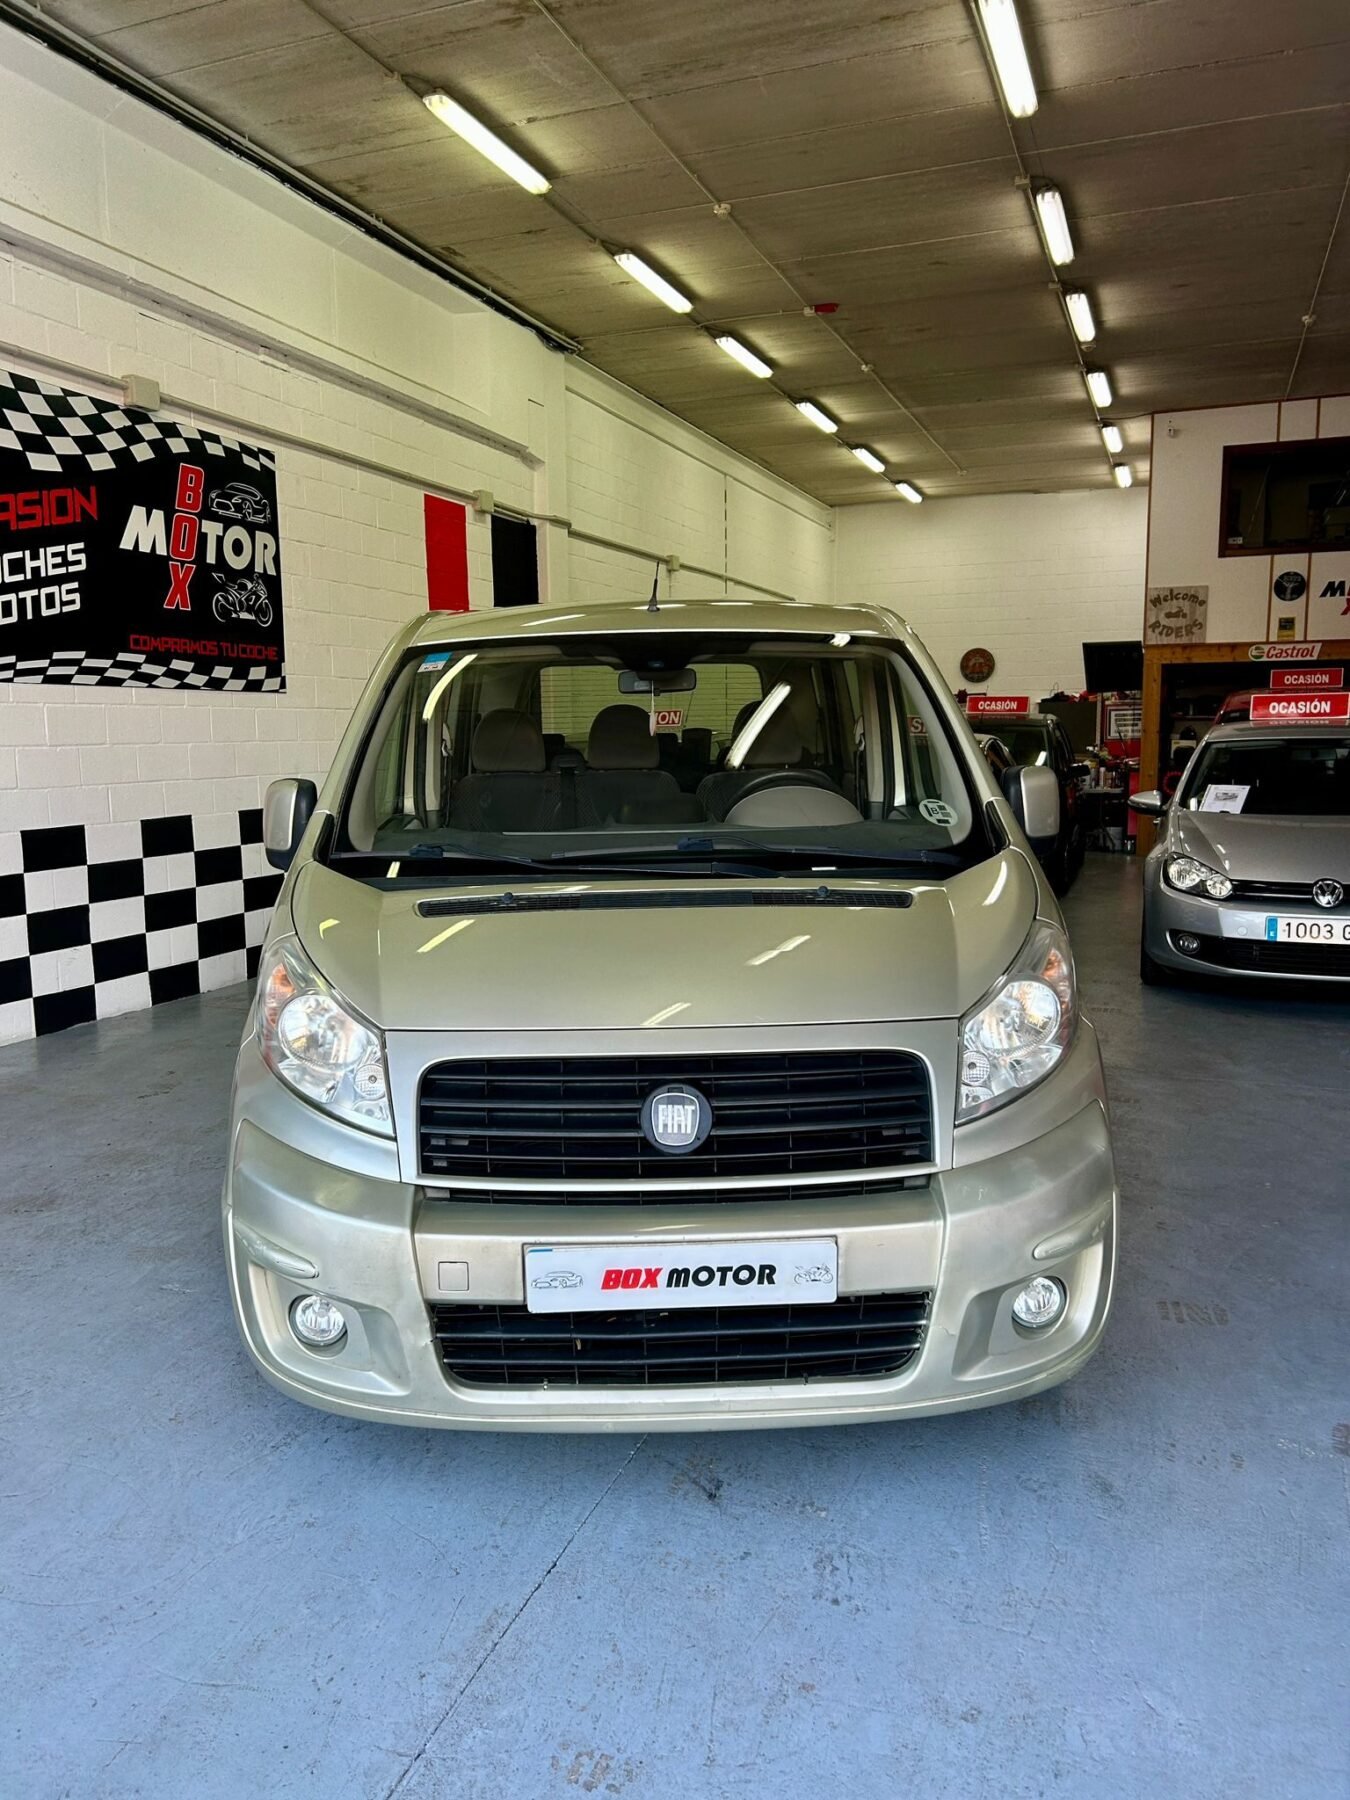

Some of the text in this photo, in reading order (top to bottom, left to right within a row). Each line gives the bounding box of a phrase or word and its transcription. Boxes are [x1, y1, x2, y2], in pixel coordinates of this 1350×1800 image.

[1149, 588, 1206, 608] Welcome
[1148, 619, 1203, 639] RIDERS
[129, 634, 279, 660] COMPRAMOS TU COCHE
[1266, 645, 1316, 659] Castrol
[1284, 671, 1329, 684] OCASIÓN
[978, 700, 1017, 710] OCASIÓN
[1269, 698, 1331, 714] OCASIÓN
[1286, 922, 1334, 940] 1003
[658, 1104, 696, 1134] FIAT
[600, 1264, 777, 1290] BOX MOTOR
